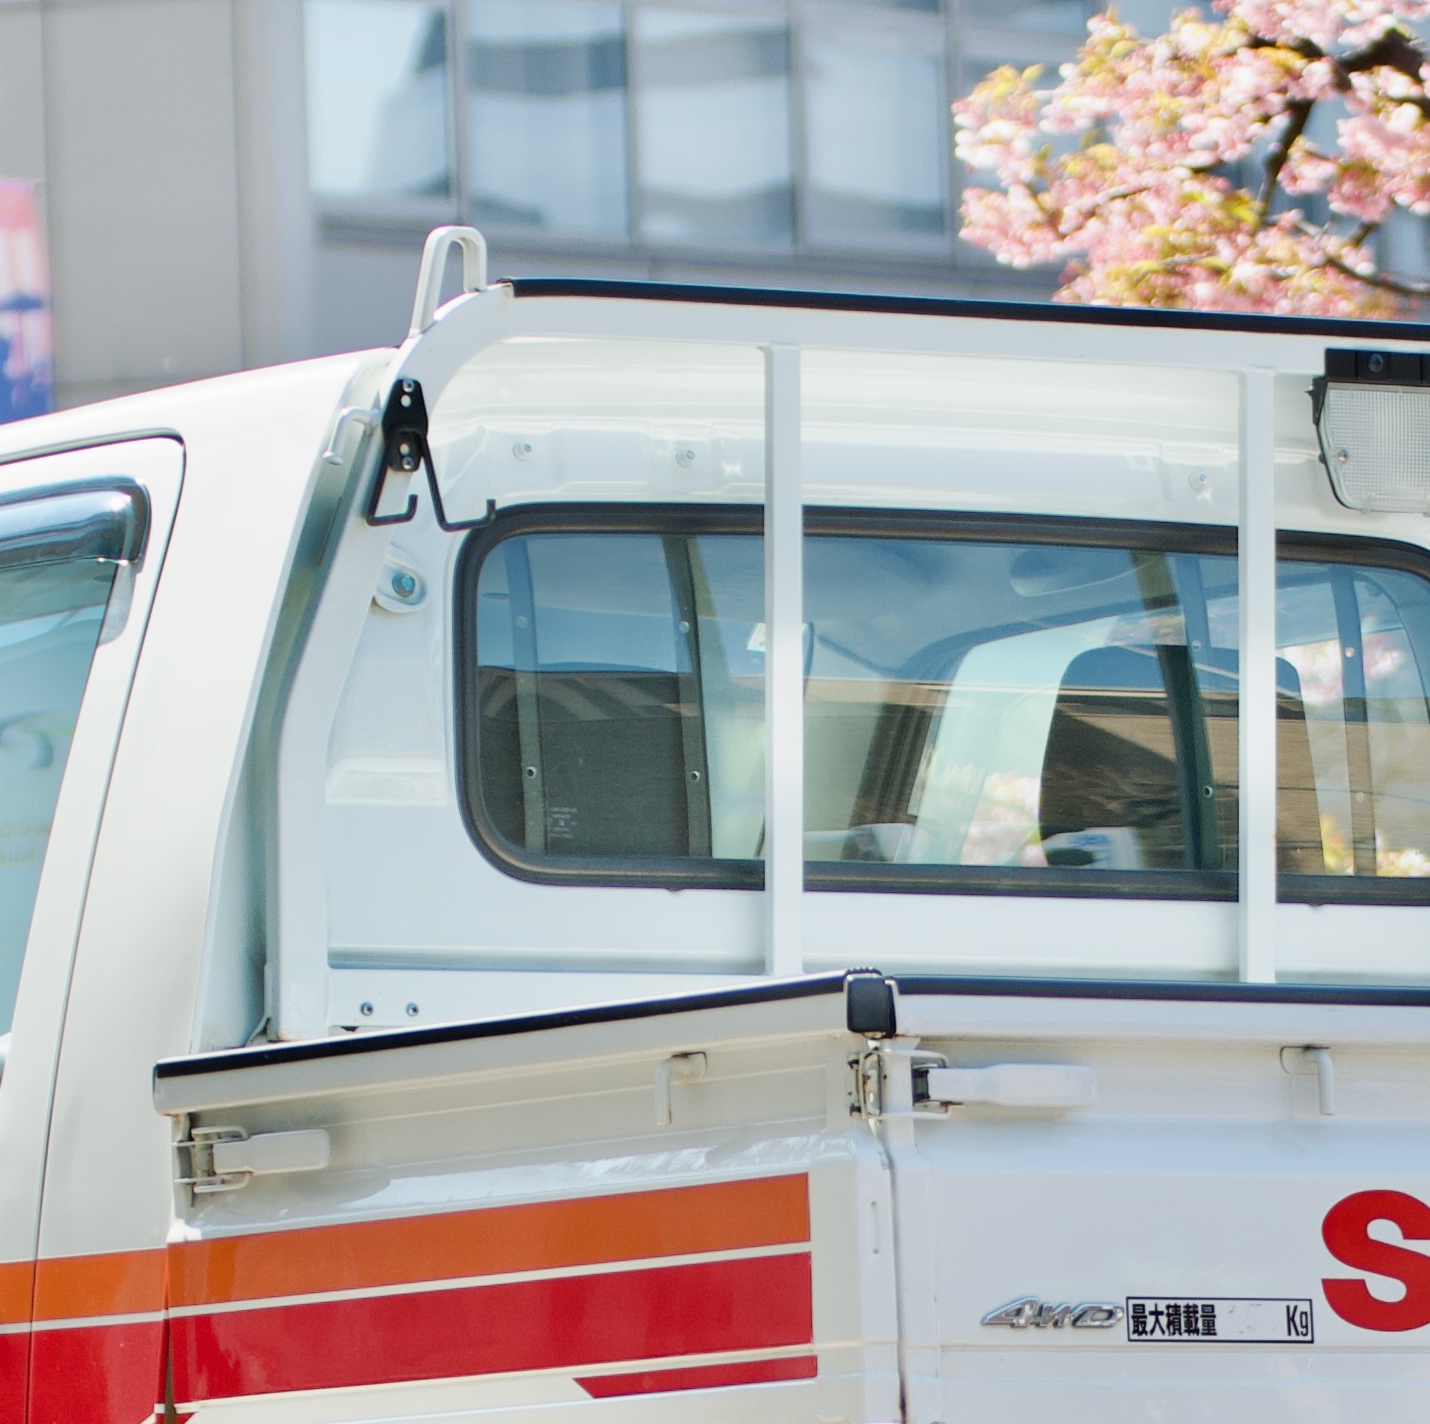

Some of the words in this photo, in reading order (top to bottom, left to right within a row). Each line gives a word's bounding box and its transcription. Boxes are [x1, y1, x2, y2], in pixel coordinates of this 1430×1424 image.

[980, 1296, 1124, 1328] 4WD
[1131, 1303, 1217, 1337] 最大積載量
[1286, 1304, 1309, 1337] Kg
